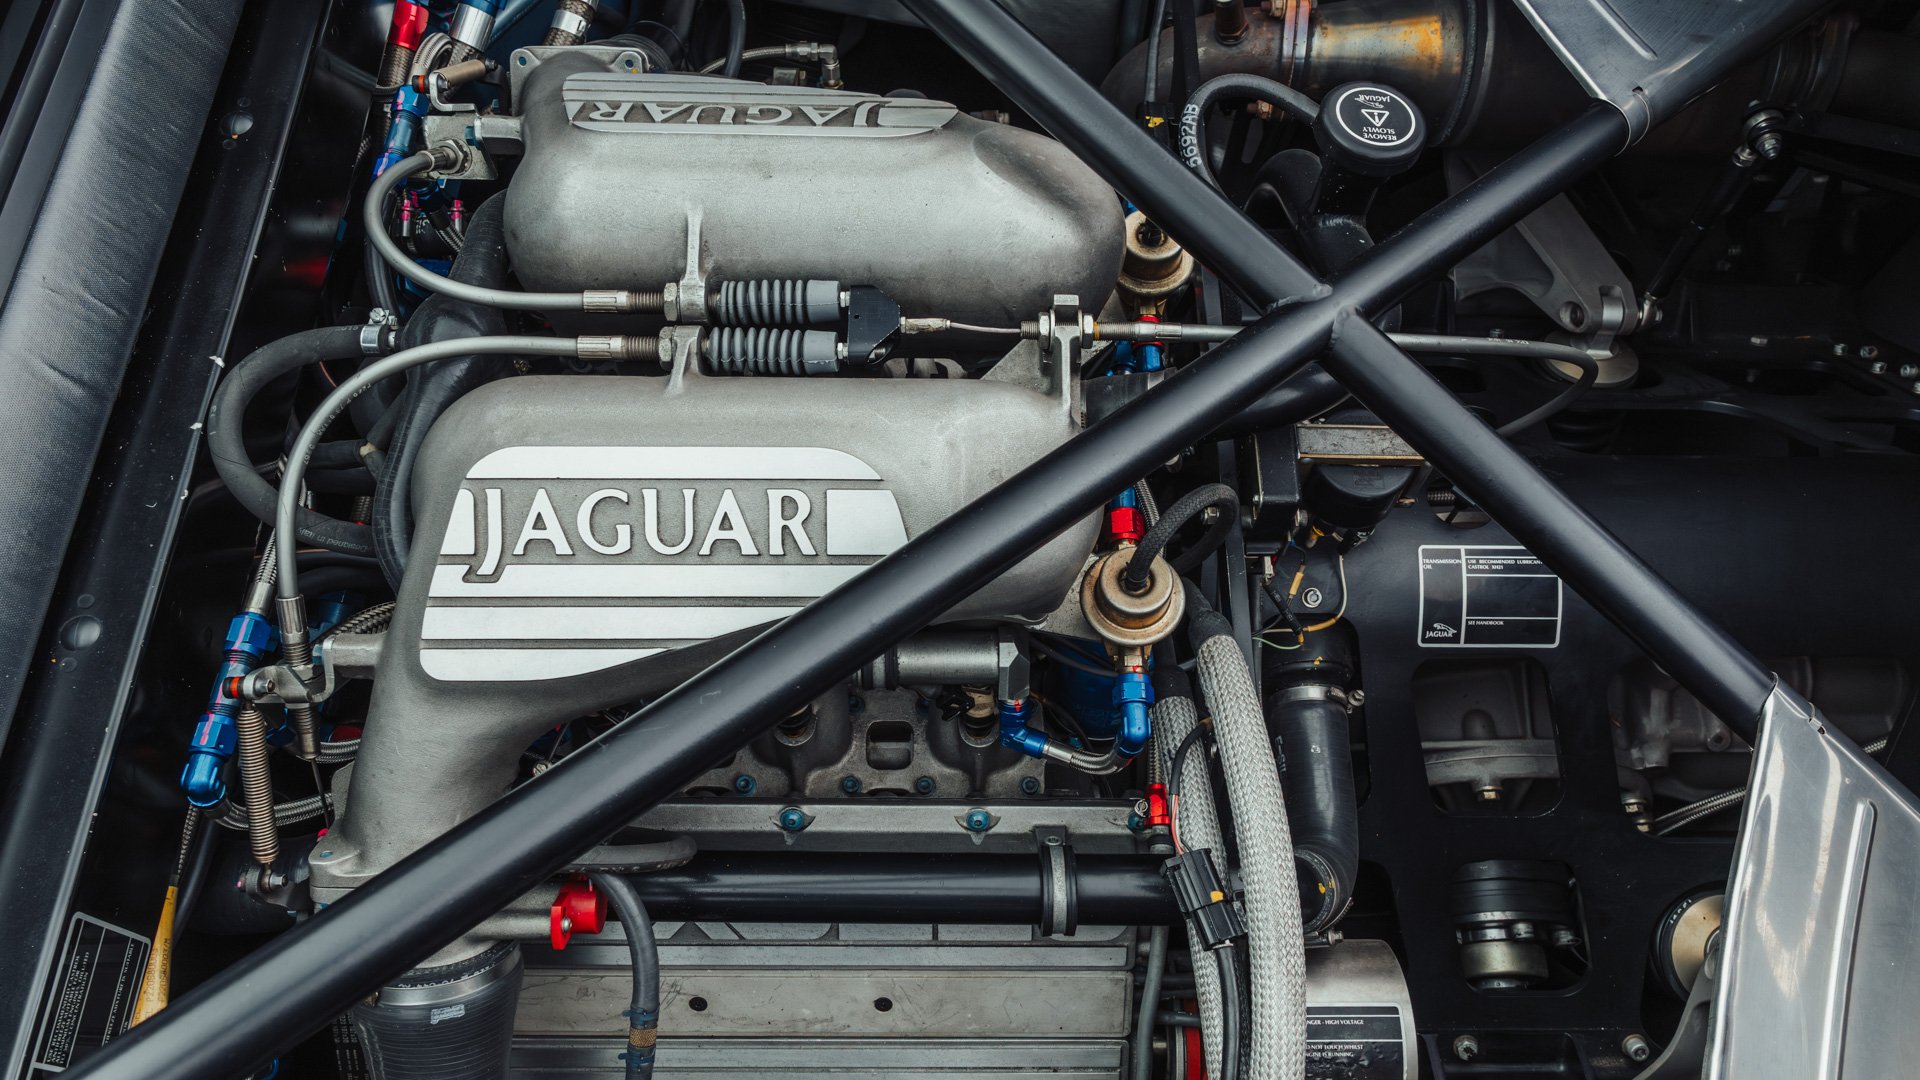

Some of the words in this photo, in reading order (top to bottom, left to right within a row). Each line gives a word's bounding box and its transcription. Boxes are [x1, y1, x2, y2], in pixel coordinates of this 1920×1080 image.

[1359, 94, 1391, 102] JAGUAR
[588, 101, 880, 127] JAGUAR
[1362, 126, 1395, 134] SLOWLY
[1363, 132, 1397, 141] REMOVE
[476, 488, 817, 575] JAGUAR
[1425, 631, 1453, 639] JAGUAR
